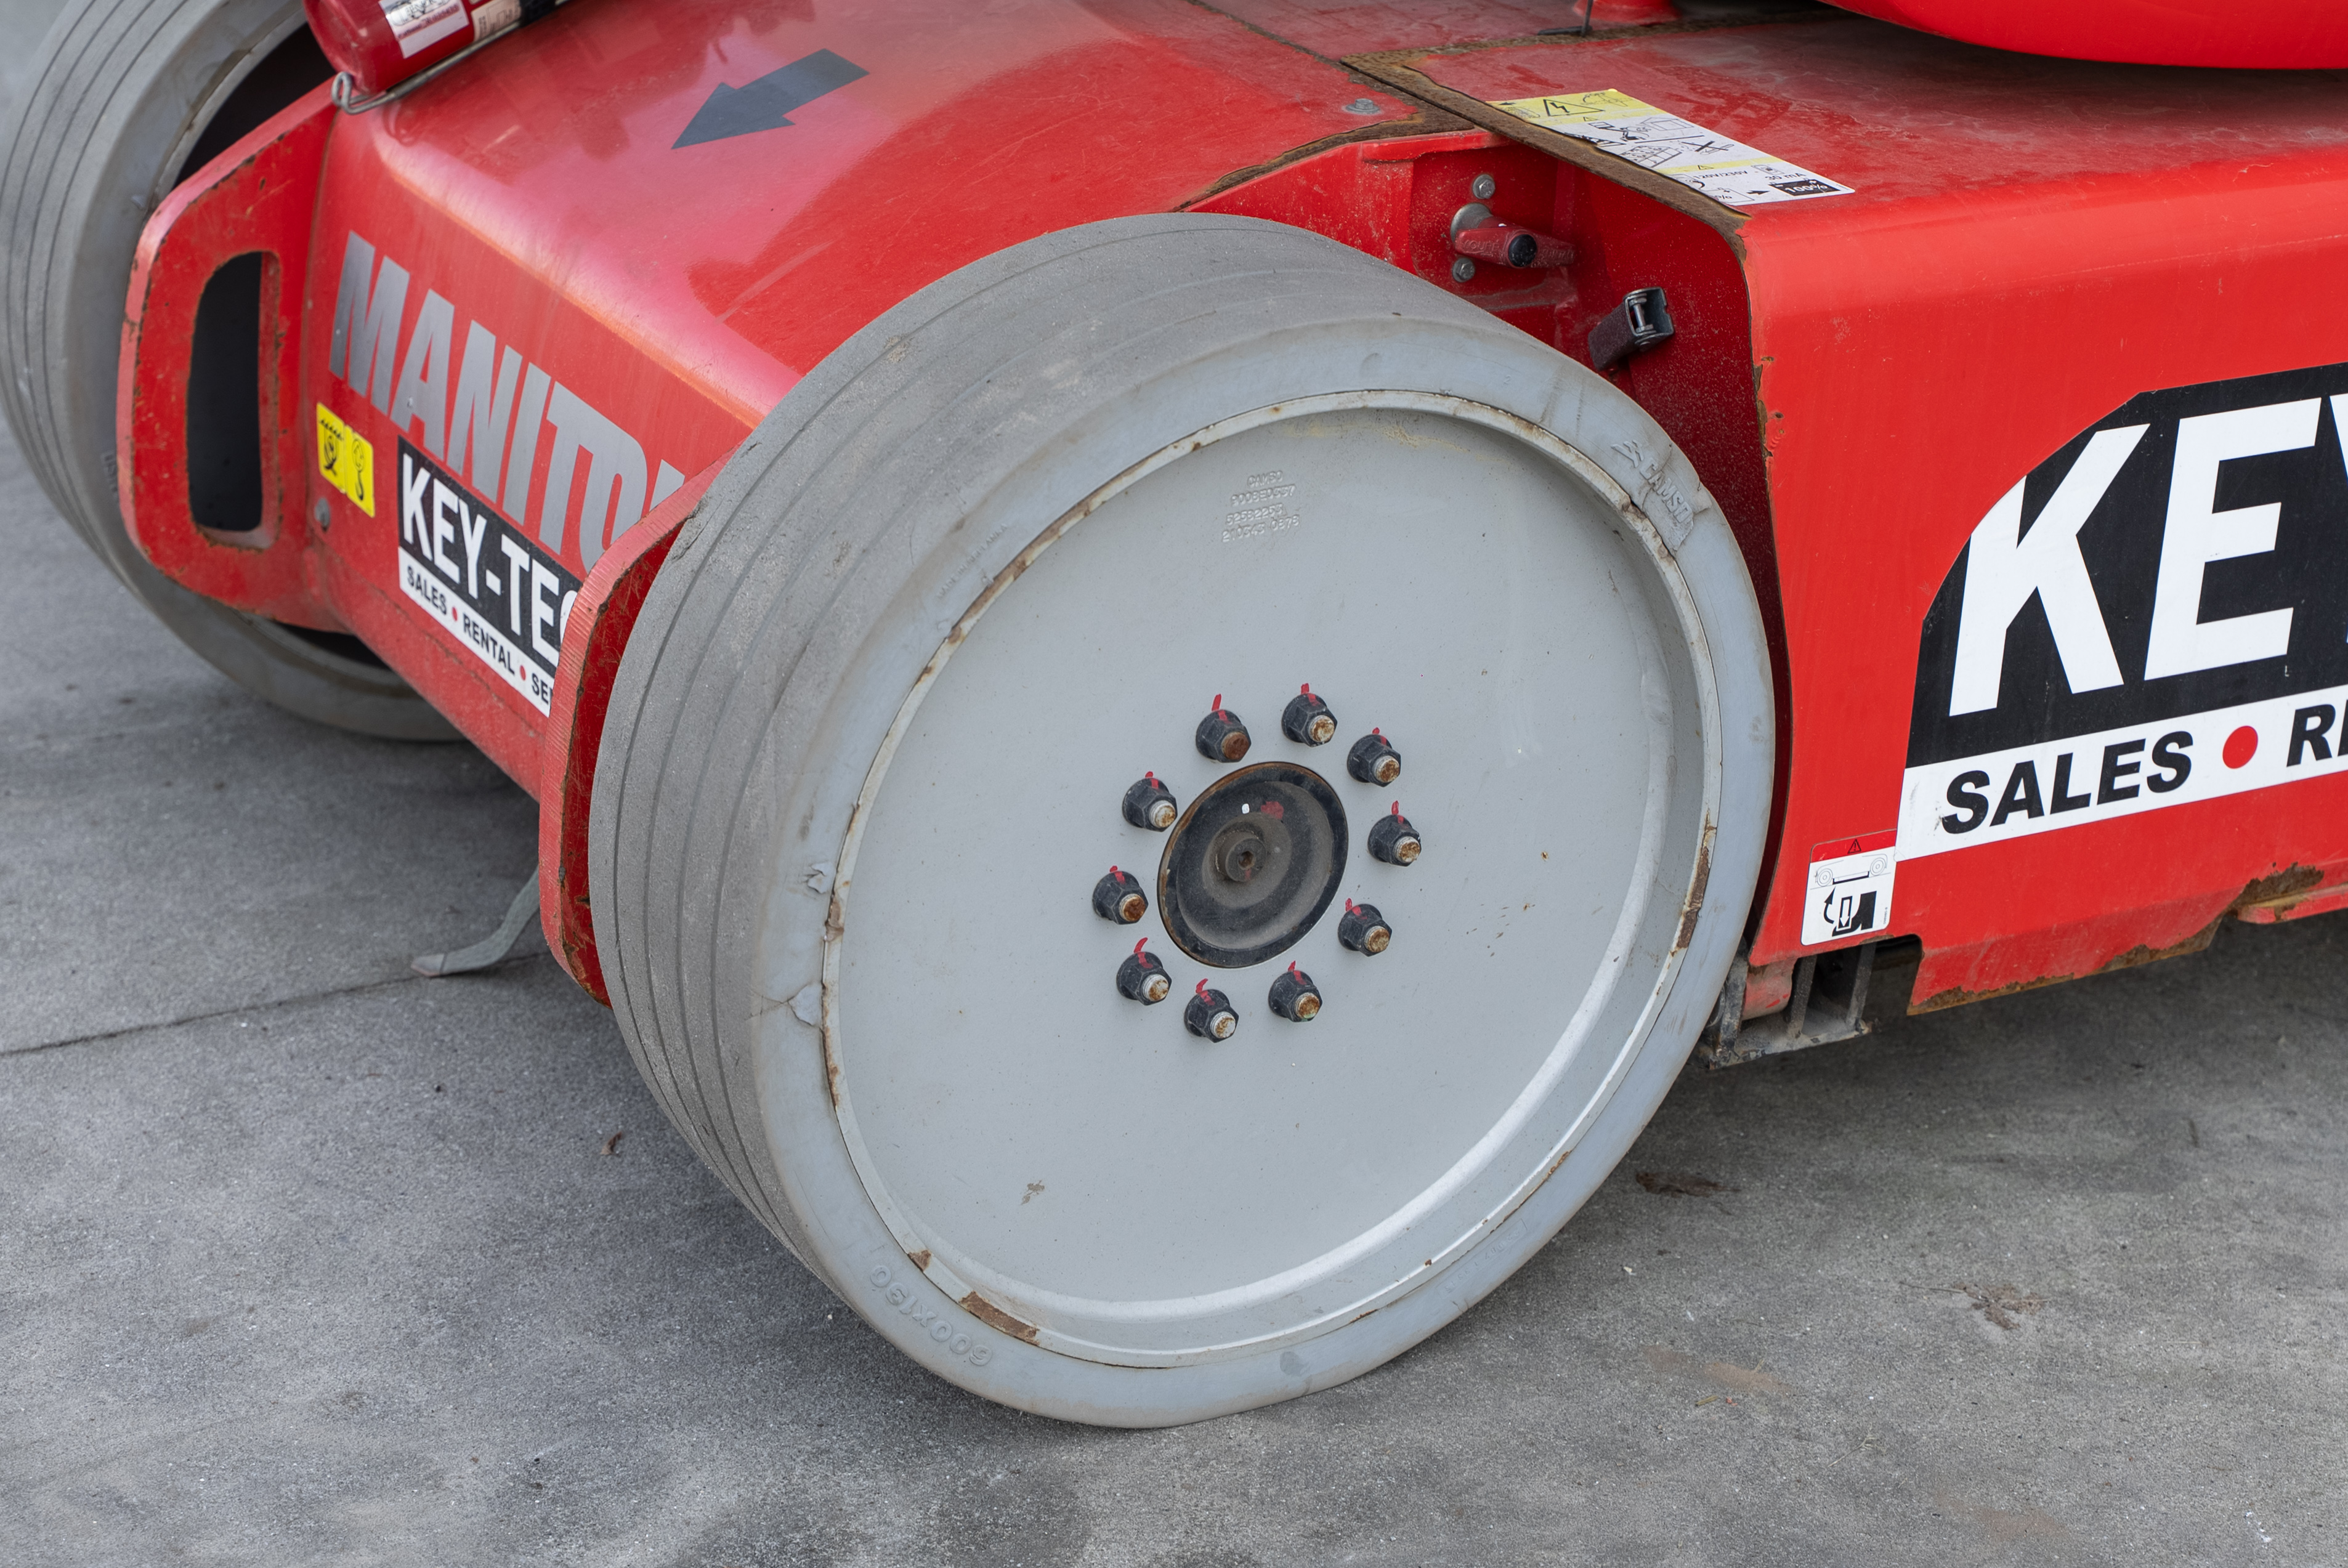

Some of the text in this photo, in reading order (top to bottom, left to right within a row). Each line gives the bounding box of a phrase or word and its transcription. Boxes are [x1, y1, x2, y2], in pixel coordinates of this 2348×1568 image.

[1784, 184, 1828, 193] 100%
[1640, 459, 1692, 523] CAMSO
[1949, 392, 2348, 717] KE
[407, 565, 553, 705] SALES RENTAL SE
[1941, 699, 2348, 835] SALES R
